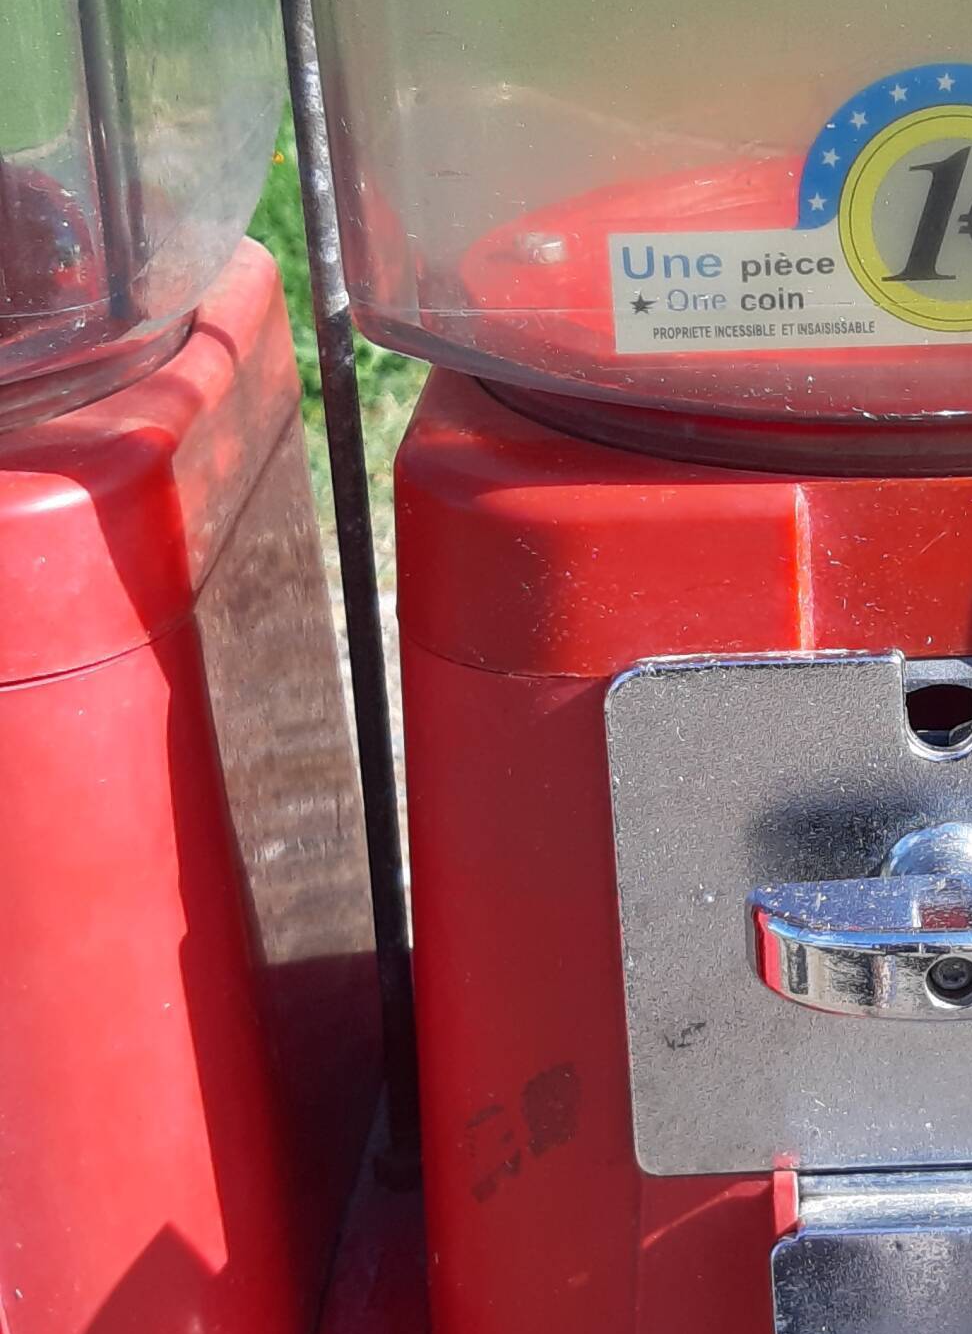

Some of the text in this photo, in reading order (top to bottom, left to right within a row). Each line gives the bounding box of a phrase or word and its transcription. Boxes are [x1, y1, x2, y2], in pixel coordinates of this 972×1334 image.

[622, 246, 836, 283] Une pièce
[667, 287, 806, 312] One coin
[653, 326, 712, 340] PROPRIETE
[714, 324, 776, 338] INCESSIBLE
[781, 323, 795, 336] ET
